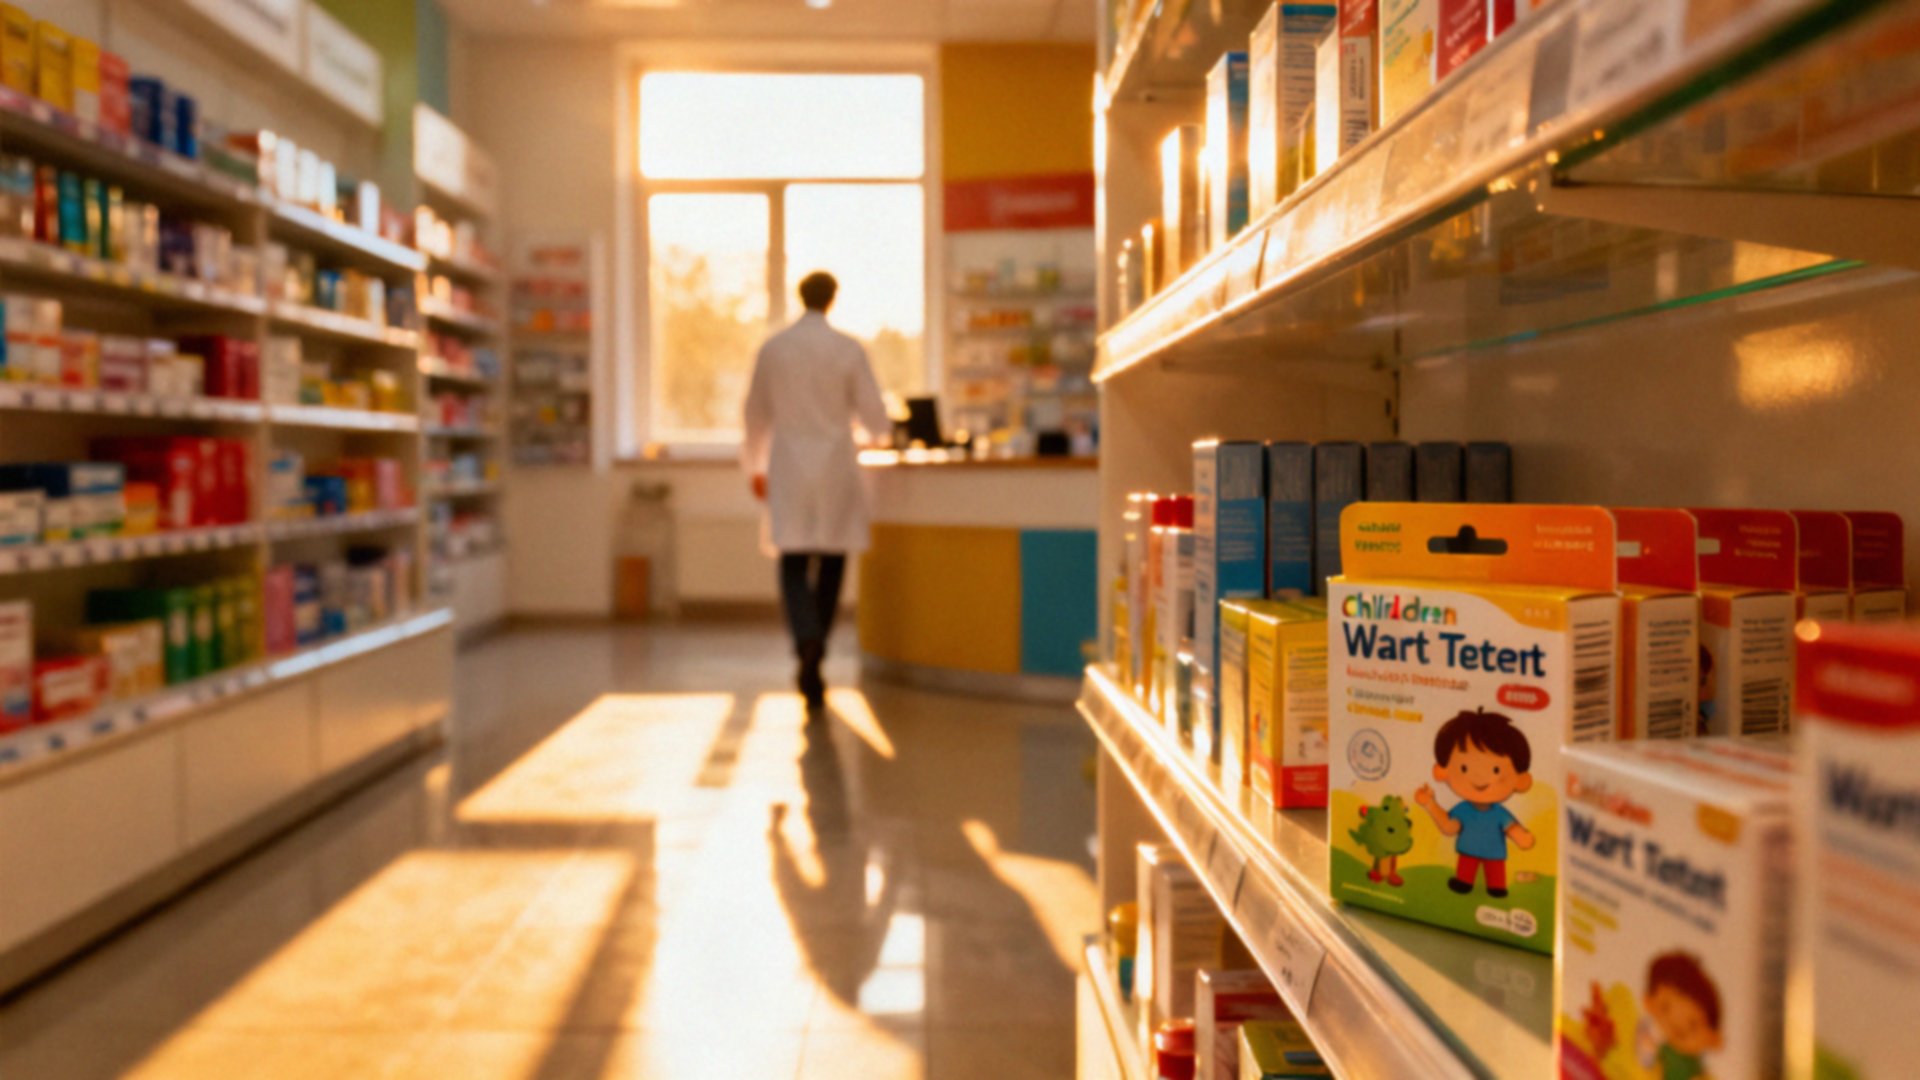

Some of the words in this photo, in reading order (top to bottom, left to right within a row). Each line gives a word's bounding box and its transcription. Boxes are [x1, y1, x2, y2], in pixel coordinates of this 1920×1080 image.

[1343, 621, 1430, 665] Wart
[1439, 632, 1546, 677] Tetert
[1566, 805, 1634, 869] Wart
